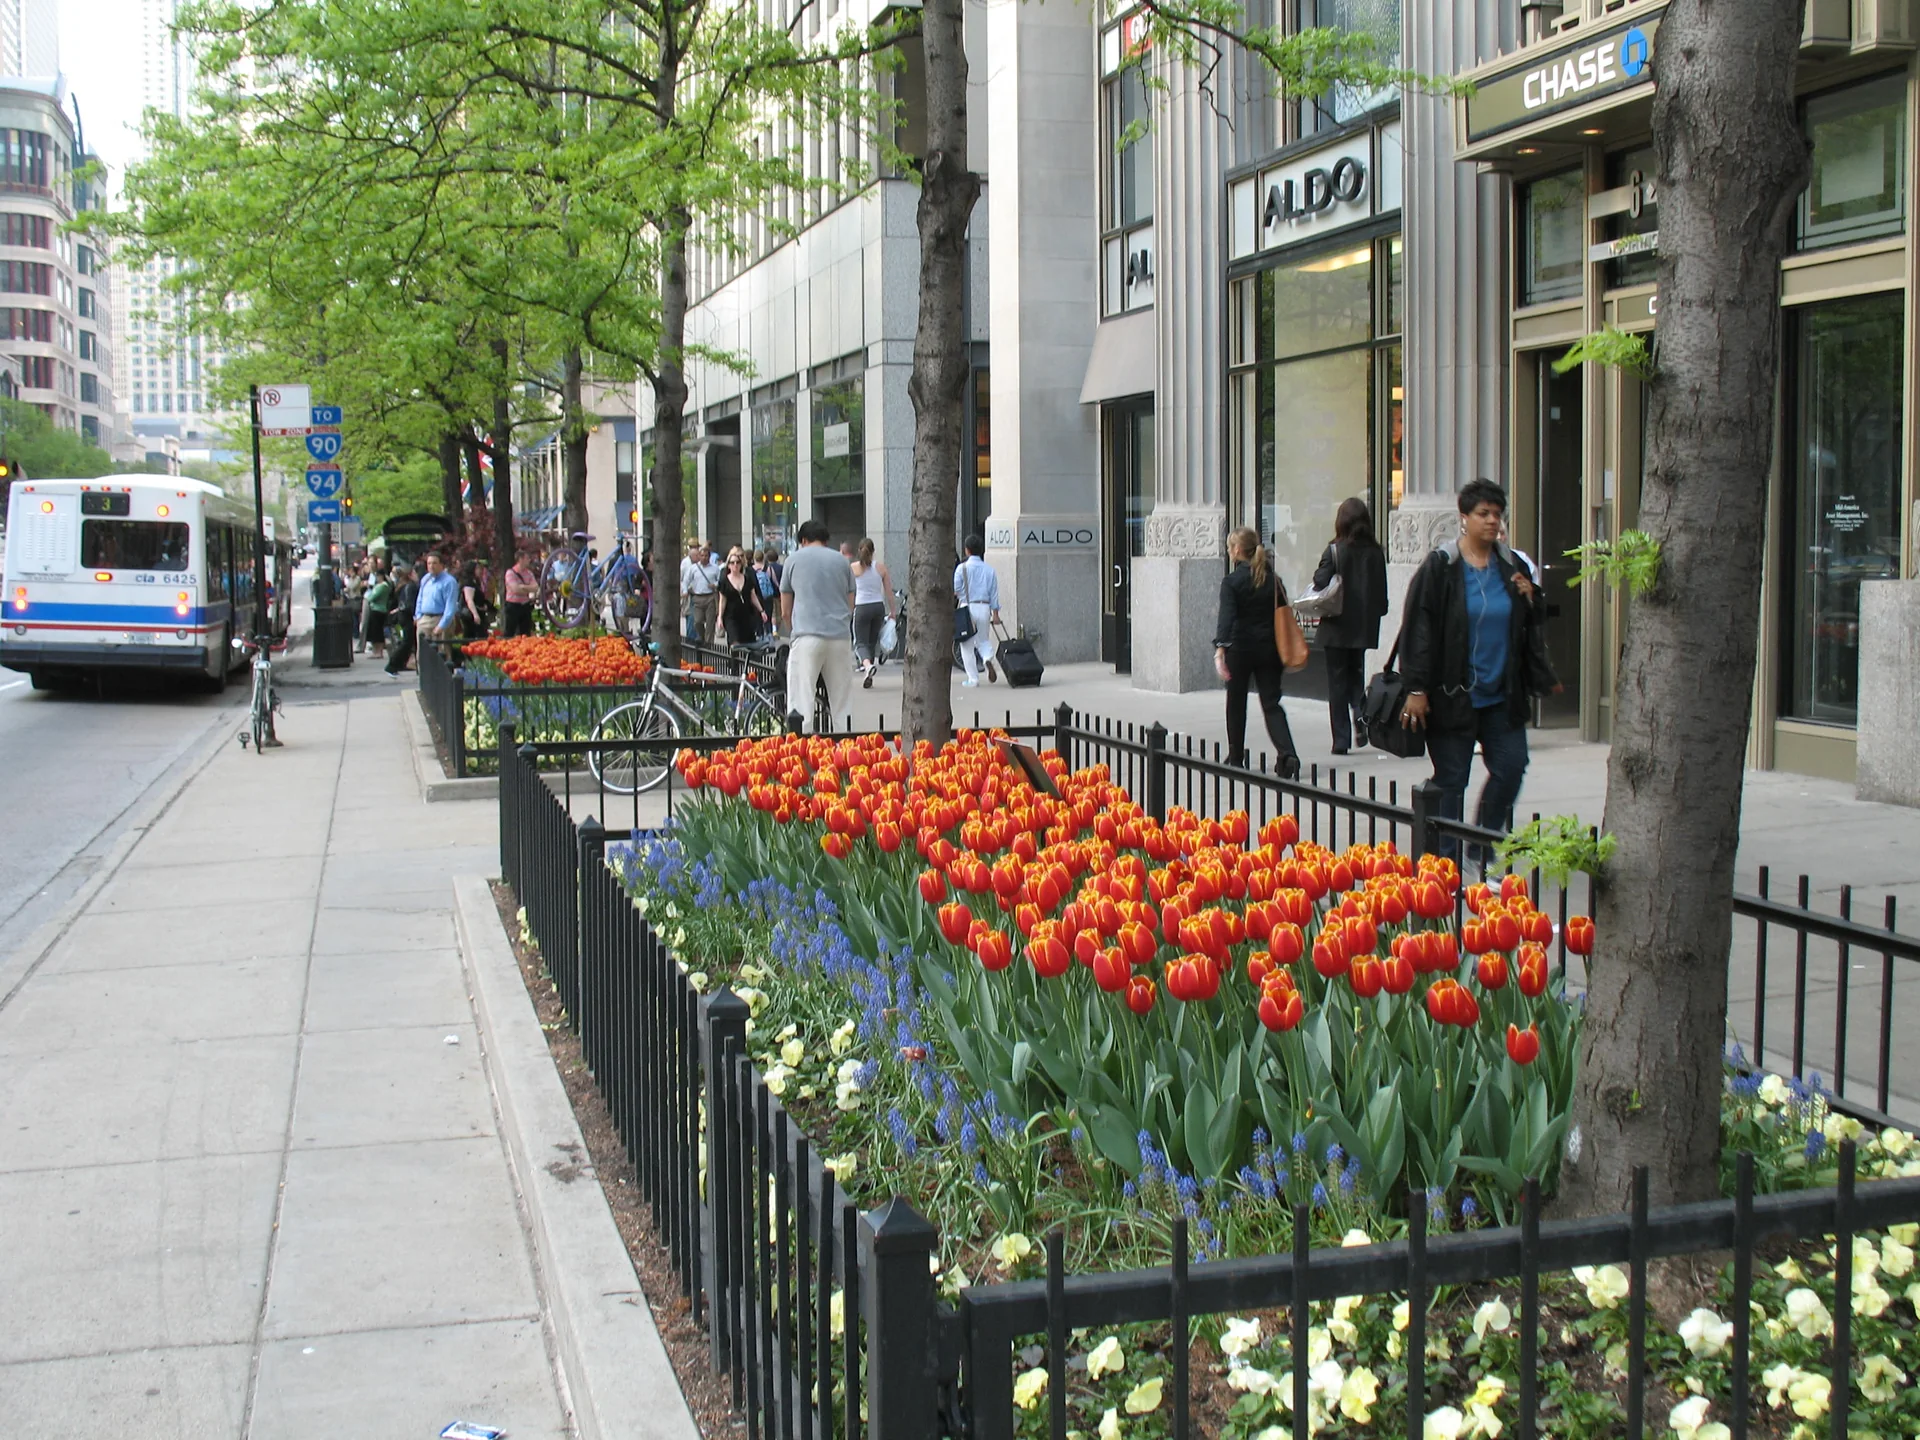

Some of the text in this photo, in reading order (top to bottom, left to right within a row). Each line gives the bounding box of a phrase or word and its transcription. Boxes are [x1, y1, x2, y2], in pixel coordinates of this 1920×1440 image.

[1523, 42, 1617, 109] CHASE
[1263, 156, 1365, 228] ALDO
[1127, 249, 1154, 286] AL
[314, 410, 333, 421] TO
[311, 437, 337, 454] 90
[310, 474, 336, 491] 94
[101, 497, 112, 511] 3
[990, 530, 1011, 544] ALDO
[1024, 529, 1093, 544] ALDO
[163, 574, 197, 584] 6425
